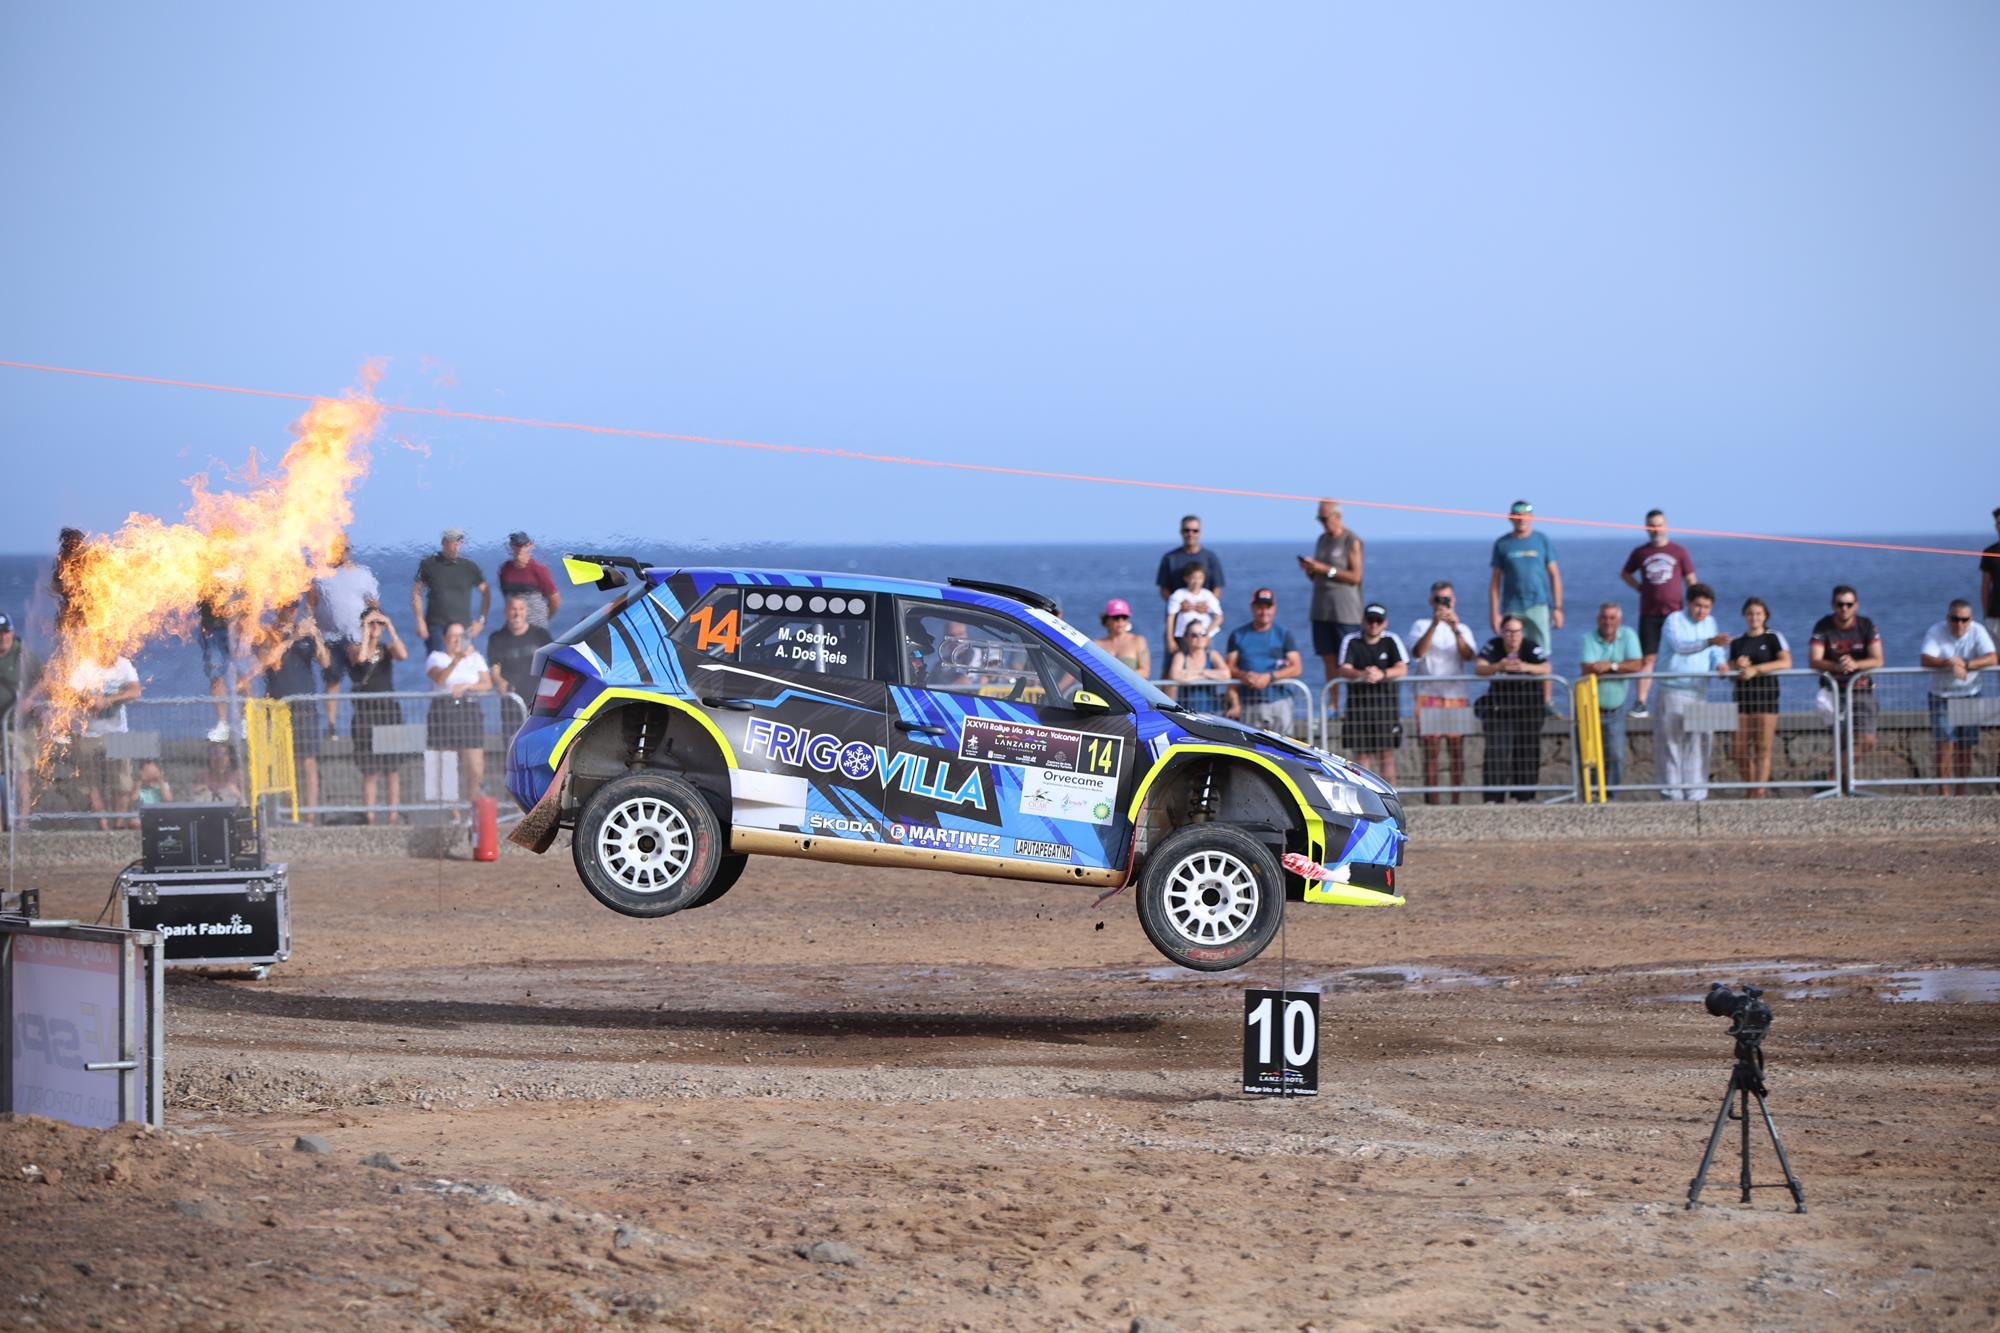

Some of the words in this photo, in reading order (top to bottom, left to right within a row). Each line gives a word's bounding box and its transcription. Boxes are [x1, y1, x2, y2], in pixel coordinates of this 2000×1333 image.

[689, 605, 740, 654] 14
[778, 627, 794, 642] M.
[796, 629, 838, 647] Osorio
[775, 645, 789, 660] A.
[792, 646, 817, 662] Dos
[820, 648, 847, 666] Reis
[967, 719, 989, 730] XXVII
[990, 722, 1010, 734] Rallye
[1025, 728, 1035, 736] de
[1036, 729, 1048, 738] Los
[1050, 731, 1080, 742] Volcanes
[994, 738, 1047, 752] LANZAROTE
[1088, 738, 1113, 774] 14
[743, 716, 988, 812] FRIGOVILLA
[1043, 770, 1104, 788] Orvecame
[809, 813, 876, 836] ŠKODA
[908, 825, 1001, 849] MARTINEZ
[908, 838, 1000, 854] FORESTAL
[1015, 839, 1072, 860] LAPUTAPEGATINA
[156, 923, 197, 939] Spark
[199, 914, 253, 935] Fabrica
[1248, 997, 1316, 1067] 10
